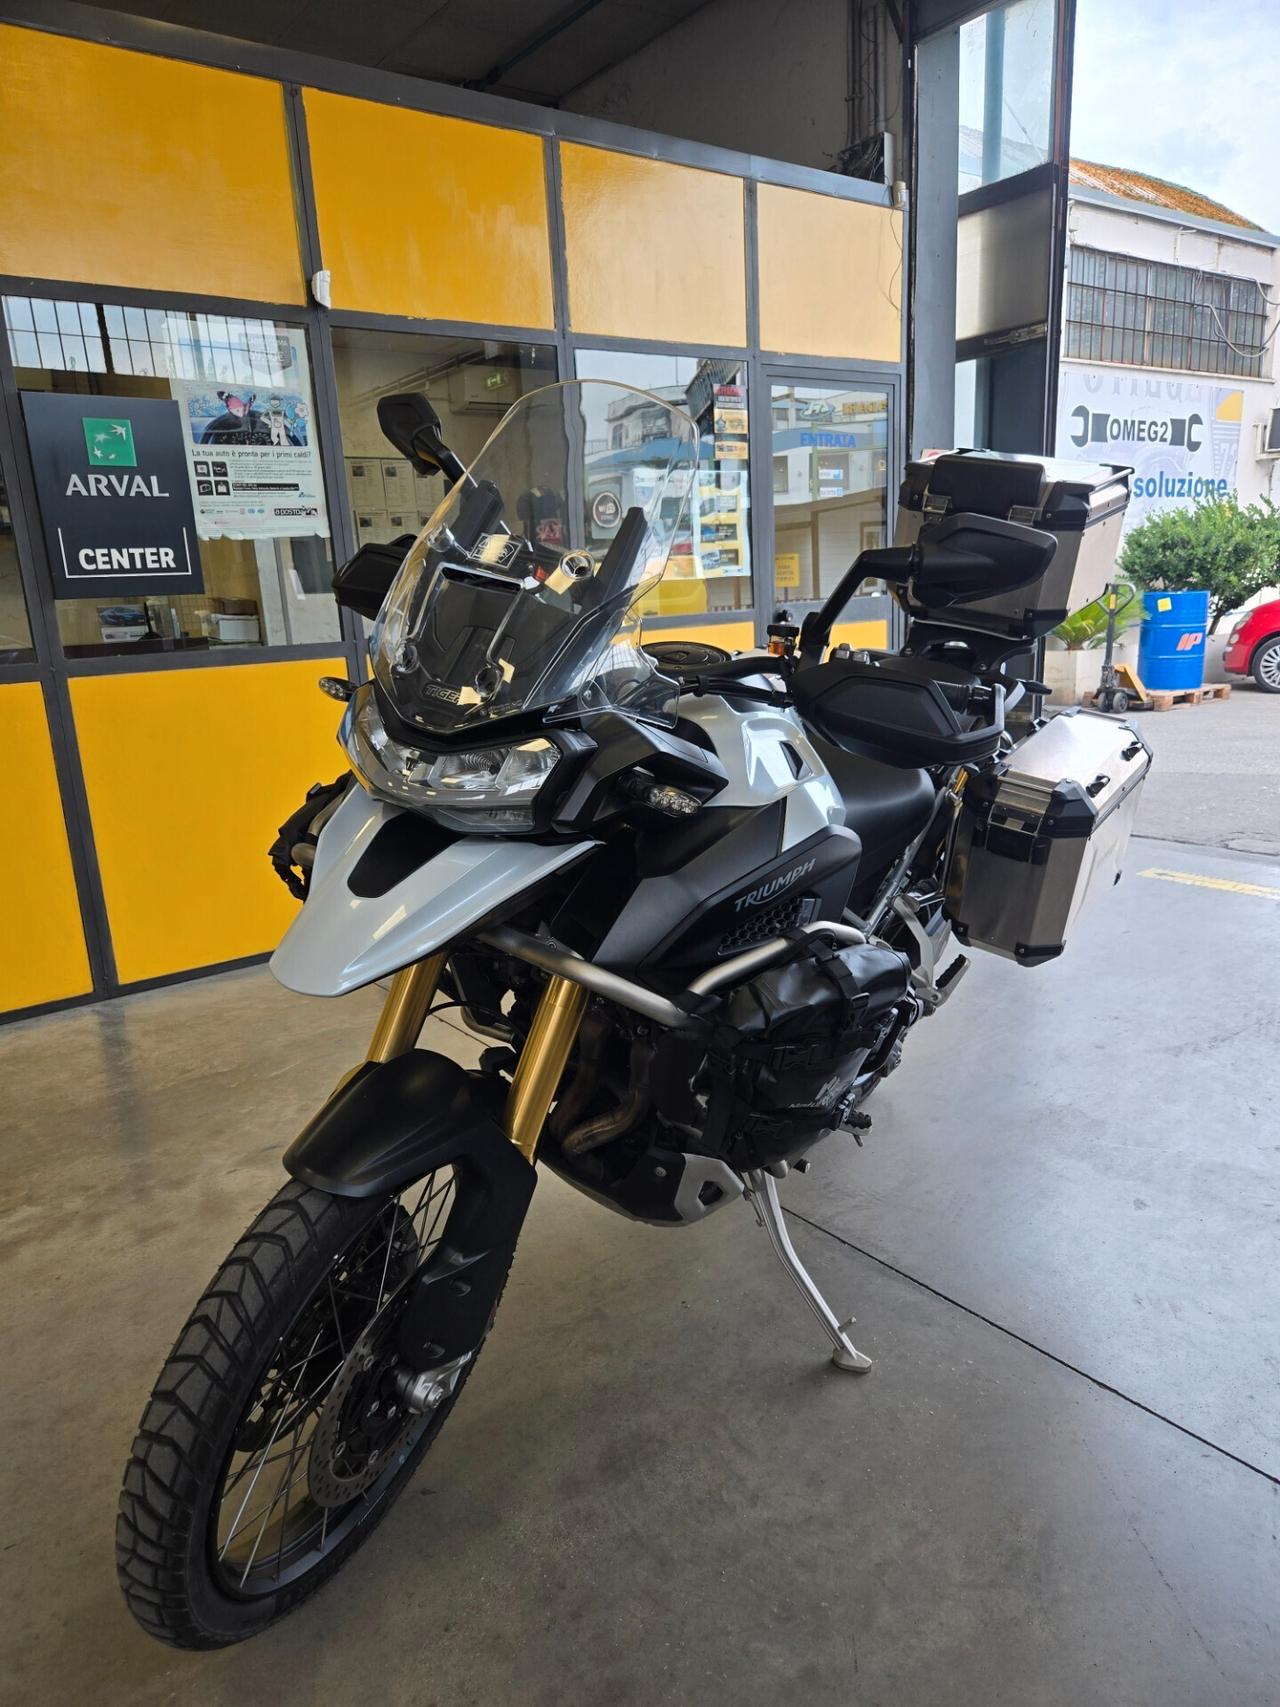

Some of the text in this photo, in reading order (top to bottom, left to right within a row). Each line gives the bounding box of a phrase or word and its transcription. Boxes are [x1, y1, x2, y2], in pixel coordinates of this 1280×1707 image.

[800, 432, 856, 448] ENTRATA
[1110, 418, 1169, 443] OMEG2
[65, 473, 170, 497] ARVAL
[1133, 471, 1228, 498] soluzione
[78, 547, 177, 570] CENTER
[1176, 632, 1203, 651] IP
[734, 858, 816, 912] TRIUMPH
